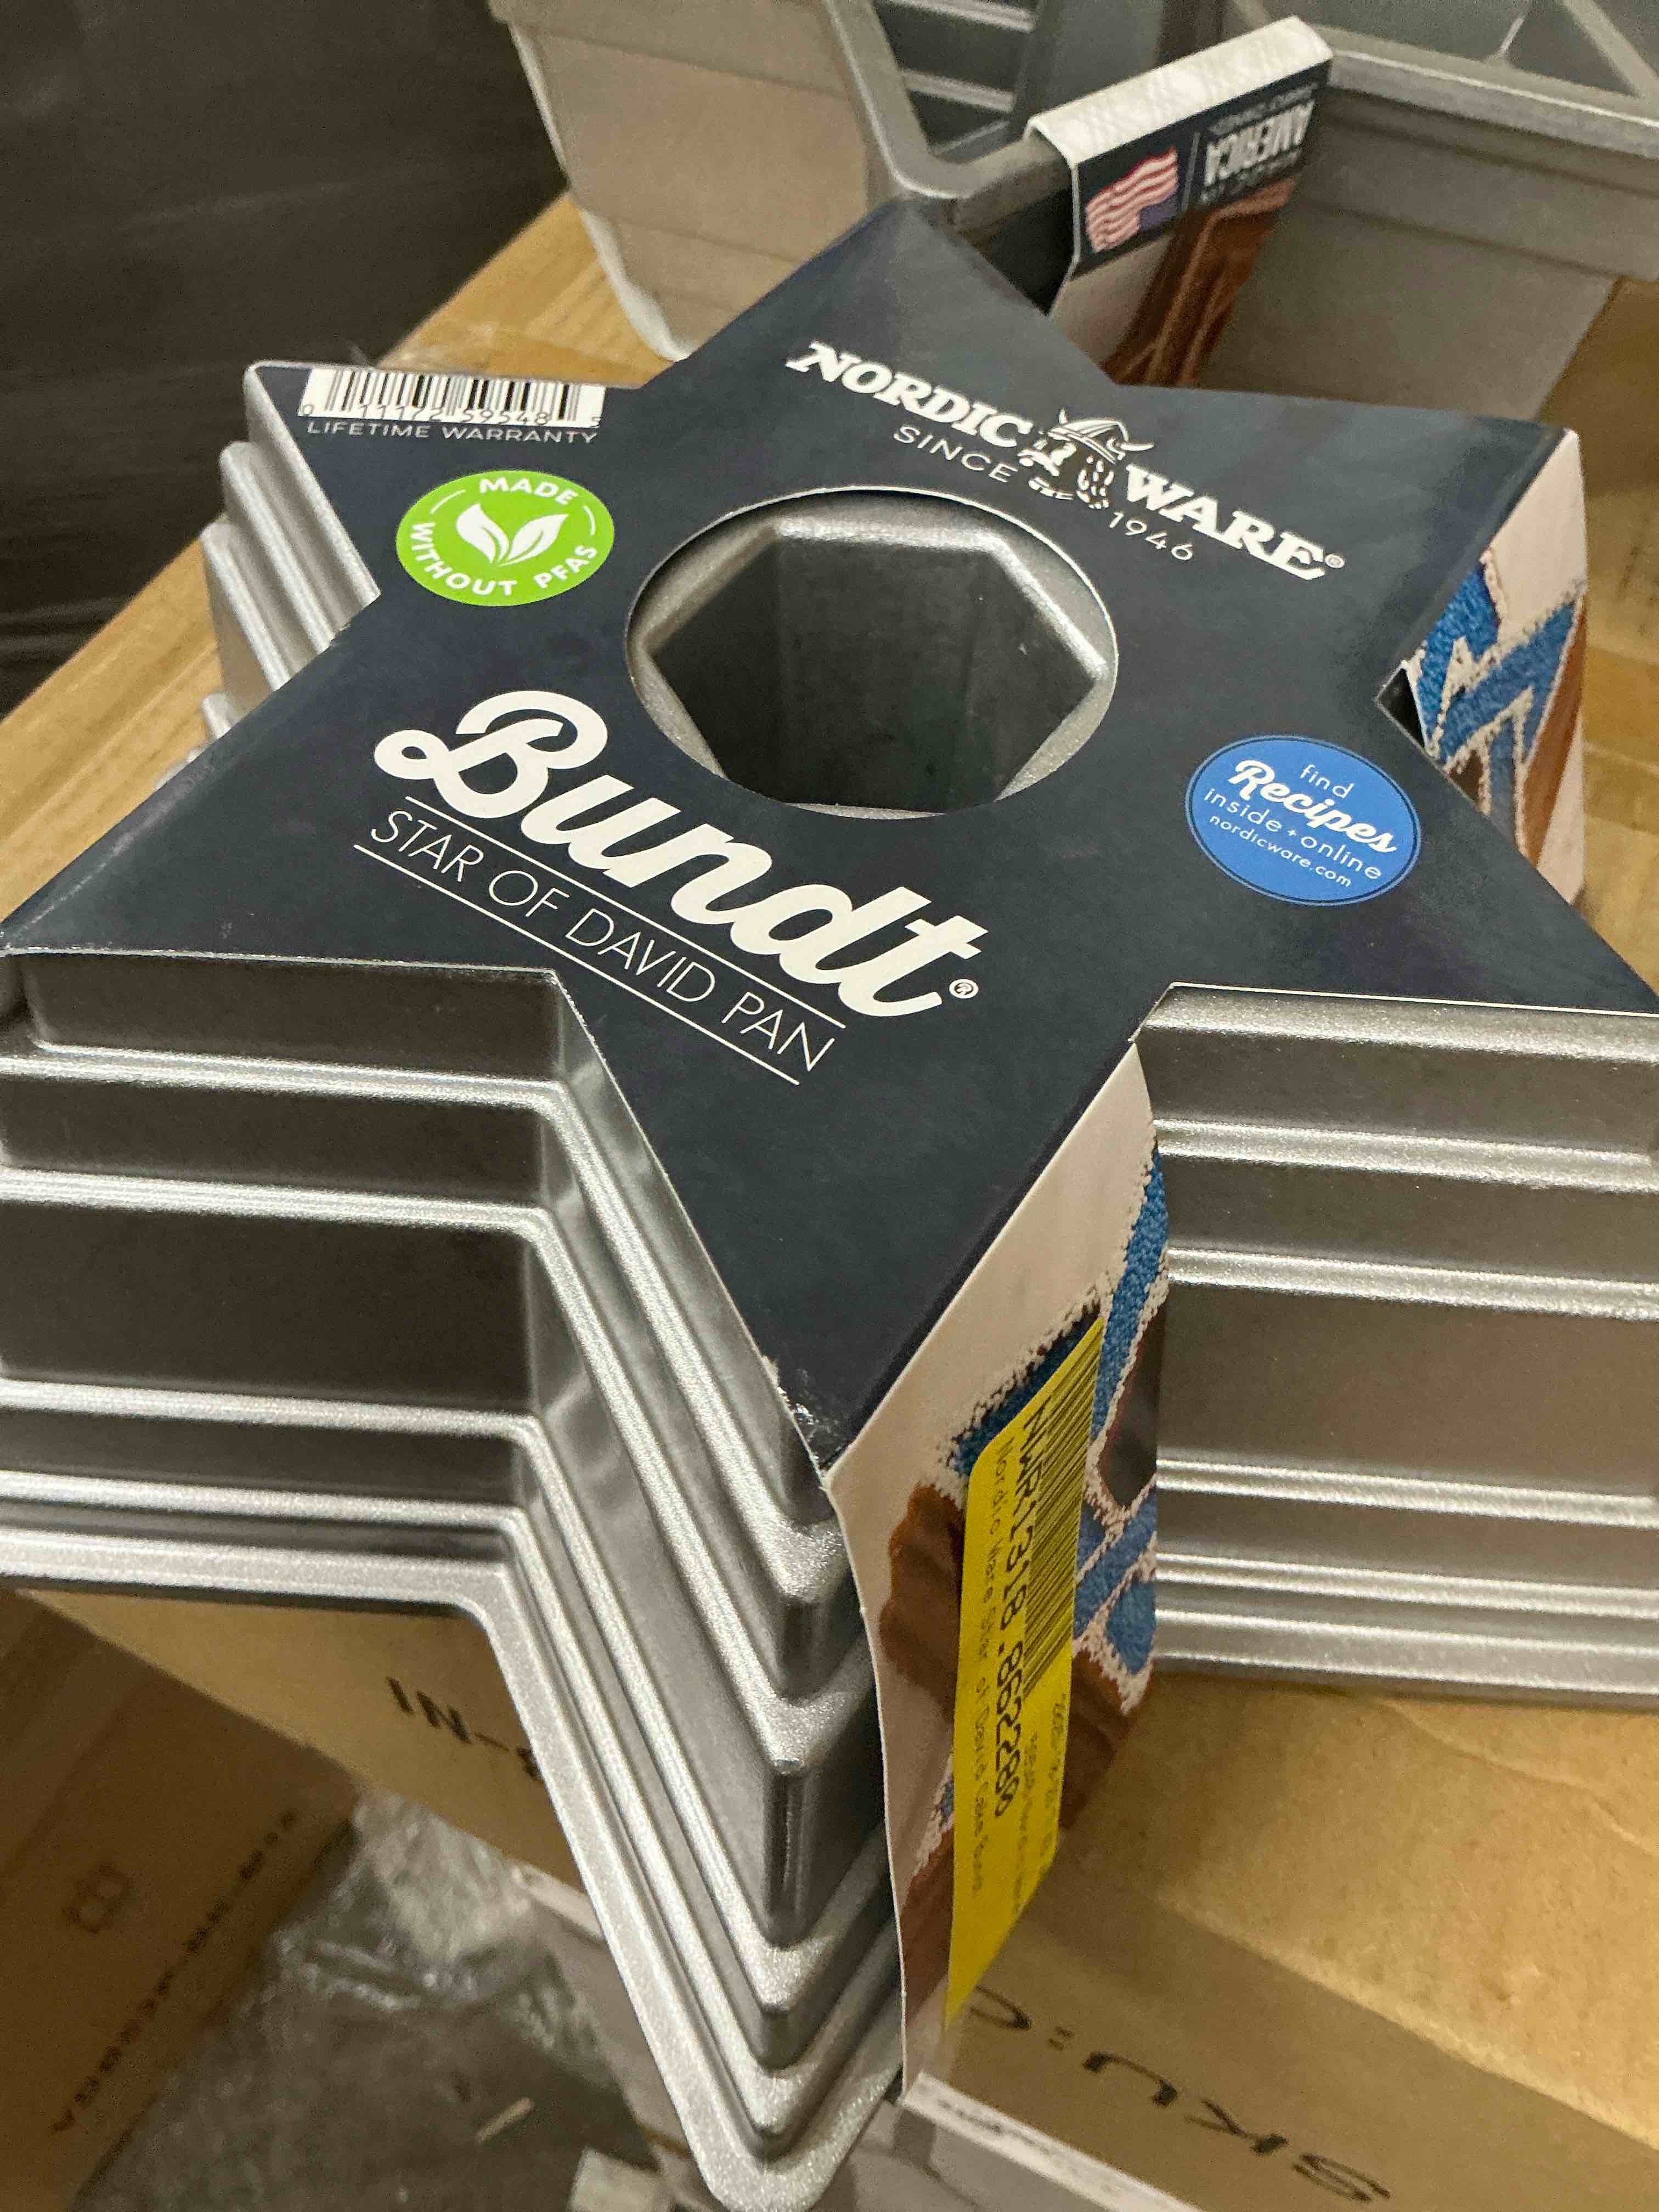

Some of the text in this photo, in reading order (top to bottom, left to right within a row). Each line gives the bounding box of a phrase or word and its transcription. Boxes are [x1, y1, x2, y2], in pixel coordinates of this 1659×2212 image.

[461, 409, 550, 426] 59548
[786, 341, 1034, 448] NORDIC
[307, 420, 597, 444] LIFETIME WARRANTY
[479, 477, 579, 505] MADE
[893, 425, 1194, 561] SINCE 1946
[410, 522, 597, 596] WITHOUT PFAS
[1228, 759, 1397, 853] Recipes
[1300, 763, 1355, 799] find
[1204, 788, 1282, 832] inside
[1300, 835, 1382, 879] online
[1209, 815, 1352, 888] nordicware.com
[371, 810, 835, 1072] STAR OF DAVID PAN
